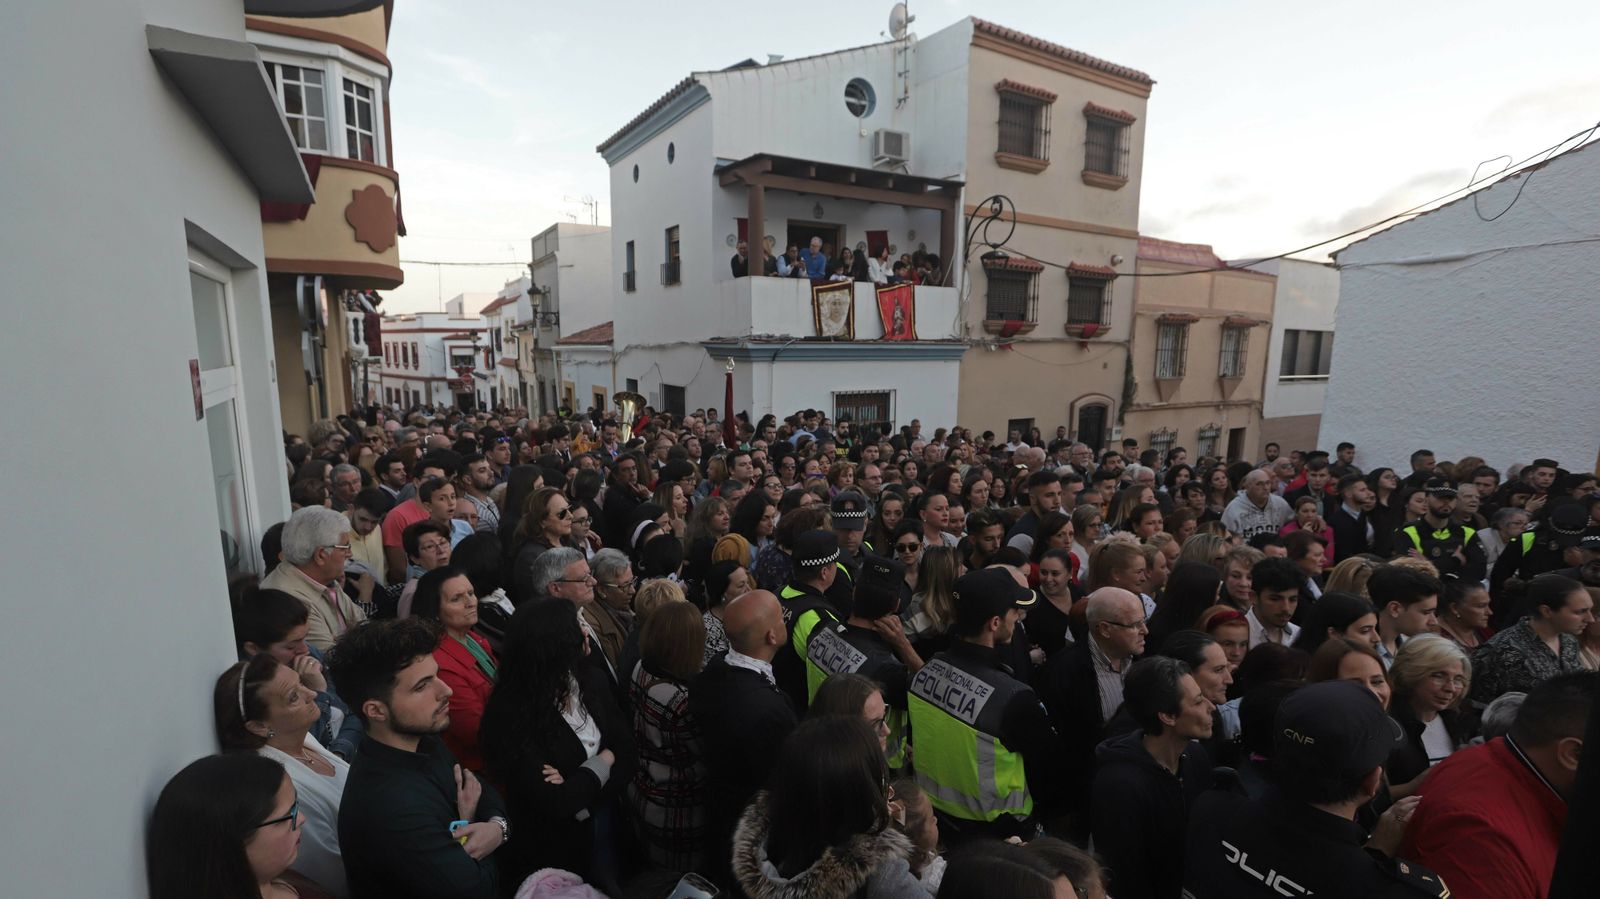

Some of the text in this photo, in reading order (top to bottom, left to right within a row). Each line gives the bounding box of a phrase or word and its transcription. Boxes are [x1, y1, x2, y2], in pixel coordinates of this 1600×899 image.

[811, 638, 851, 673] POLICIA
[851, 653, 863, 664] DE
[914, 671, 977, 719] POLICIA
[944, 669, 974, 691] NACIONAL
[974, 684, 989, 698] DE
[1283, 728, 1315, 745] CNP
